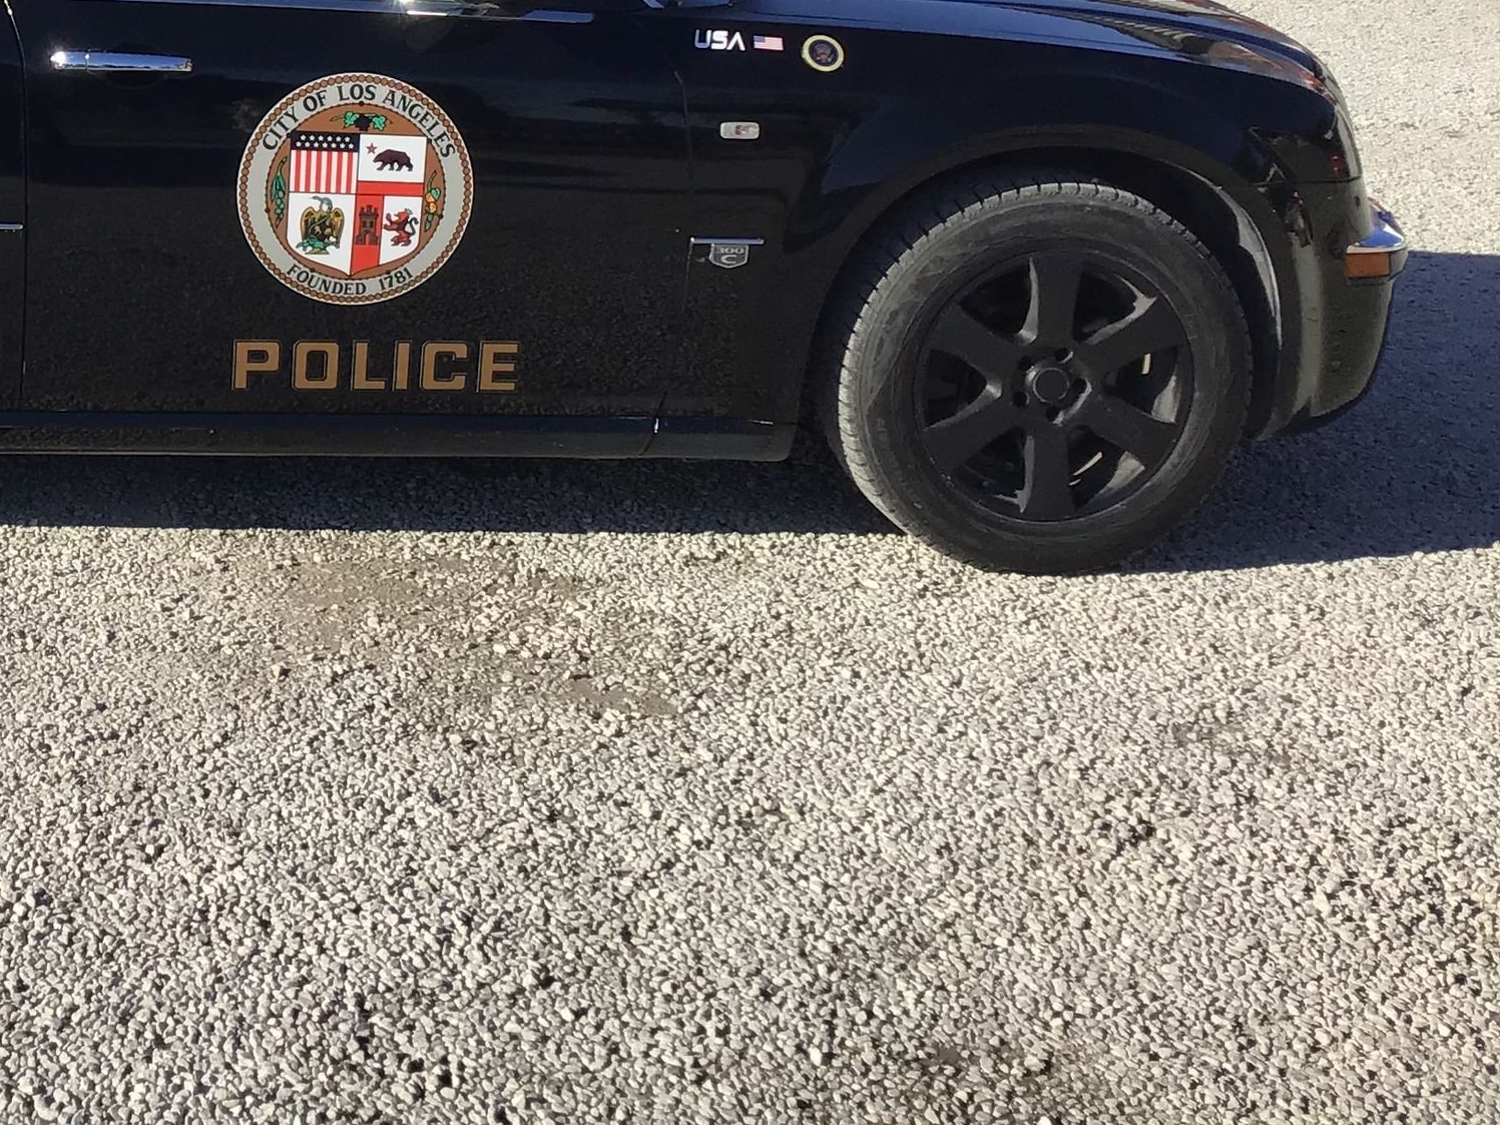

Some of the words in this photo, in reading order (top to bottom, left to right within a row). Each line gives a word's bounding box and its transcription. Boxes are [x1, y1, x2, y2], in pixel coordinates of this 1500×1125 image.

[693, 28, 747, 52] USA
[262, 105, 300, 152] CITY
[302, 88, 330, 114] OF
[337, 83, 378, 103] LOS
[381, 88, 457, 160] ANGELES
[286, 262, 368, 296] FOUNDED
[377, 266, 415, 291] 1781
[230, 338, 521, 394] POLICE
